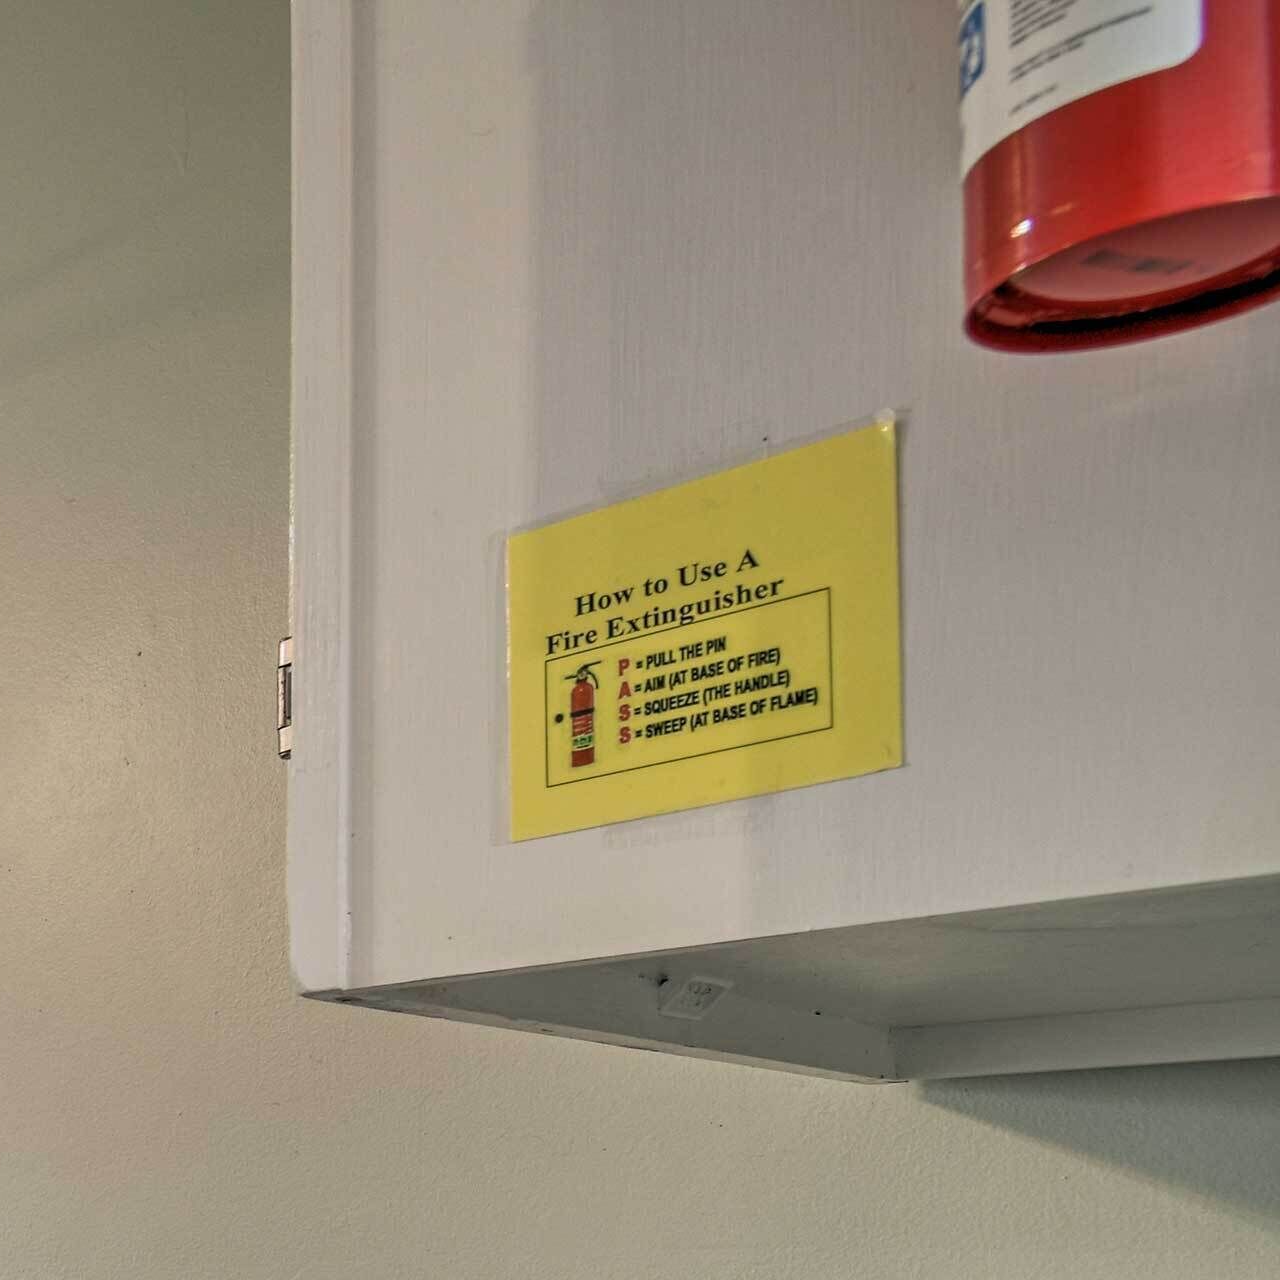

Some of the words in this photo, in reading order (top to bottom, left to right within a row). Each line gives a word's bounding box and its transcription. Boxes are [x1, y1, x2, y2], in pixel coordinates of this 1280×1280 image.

[574, 584, 634, 618] How
[643, 575, 669, 597] to
[679, 560, 728, 589] Use
[736, 549, 760, 572] A
[546, 627, 598, 655] Fire
[607, 578, 785, 638] Extinguisher
[618, 659, 630, 676] P
[646, 651, 676, 670] PULL
[679, 643, 704, 661] THE
[706, 636, 727, 655] PIN
[618, 681, 631, 699] A
[644, 675, 666, 693] AIM
[669, 671, 688, 690] (AT
[691, 661, 724, 682] BASE
[728, 656, 744, 673] OF
[748, 647, 781, 668] FIRE)
[618, 704, 631, 722] S
[644, 691, 700, 716] SQUEEZE
[703, 683, 731, 706] (THE
[735, 669, 790, 695] HANDLE)
[618, 727, 631, 744] S
[645, 717, 687, 739] SWEEP
[690, 713, 709, 732] (AT
[713, 703, 746, 723] BASE
[749, 698, 767, 715] OF
[770, 687, 818, 711] FLAME)
